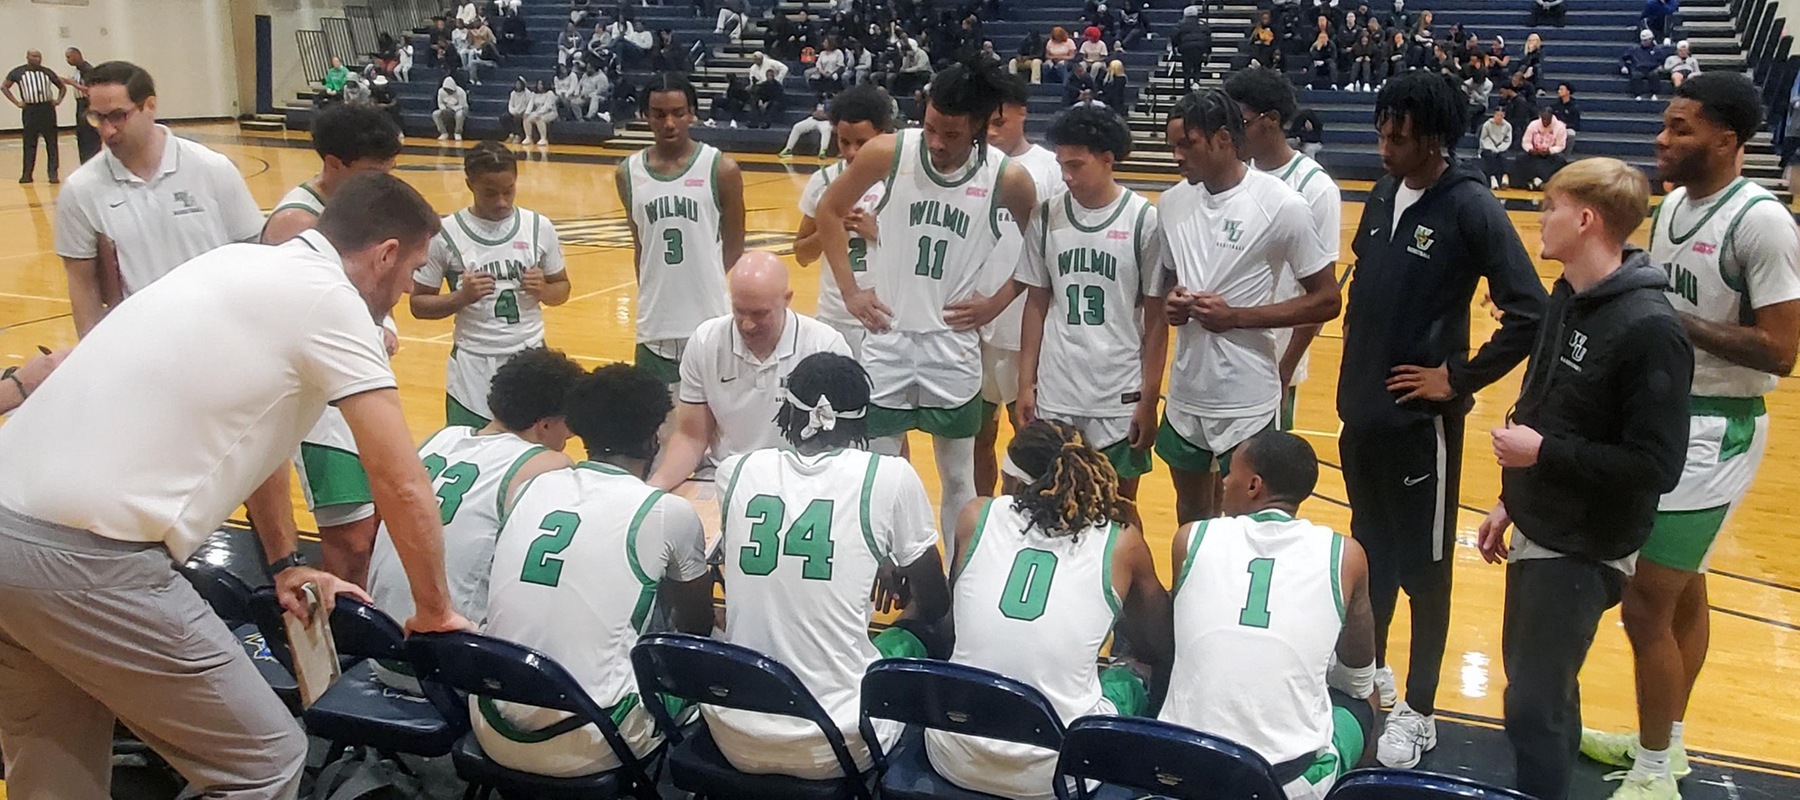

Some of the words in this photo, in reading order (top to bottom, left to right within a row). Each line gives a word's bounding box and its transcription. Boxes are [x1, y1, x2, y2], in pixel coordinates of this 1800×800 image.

[644, 195, 698, 225] WILMU
[909, 200, 970, 239] WILMU
[1222, 218, 1245, 242] WU
[663, 228, 683, 265] 3
[915, 235, 948, 280] 11
[1058, 247, 1117, 282] WILMU
[494, 289, 520, 324] 4
[1066, 284, 1105, 325] 13
[520, 509, 582, 588] 2
[739, 493, 835, 581] 34
[998, 547, 1059, 622] 0
[1238, 557, 1276, 629] 1
